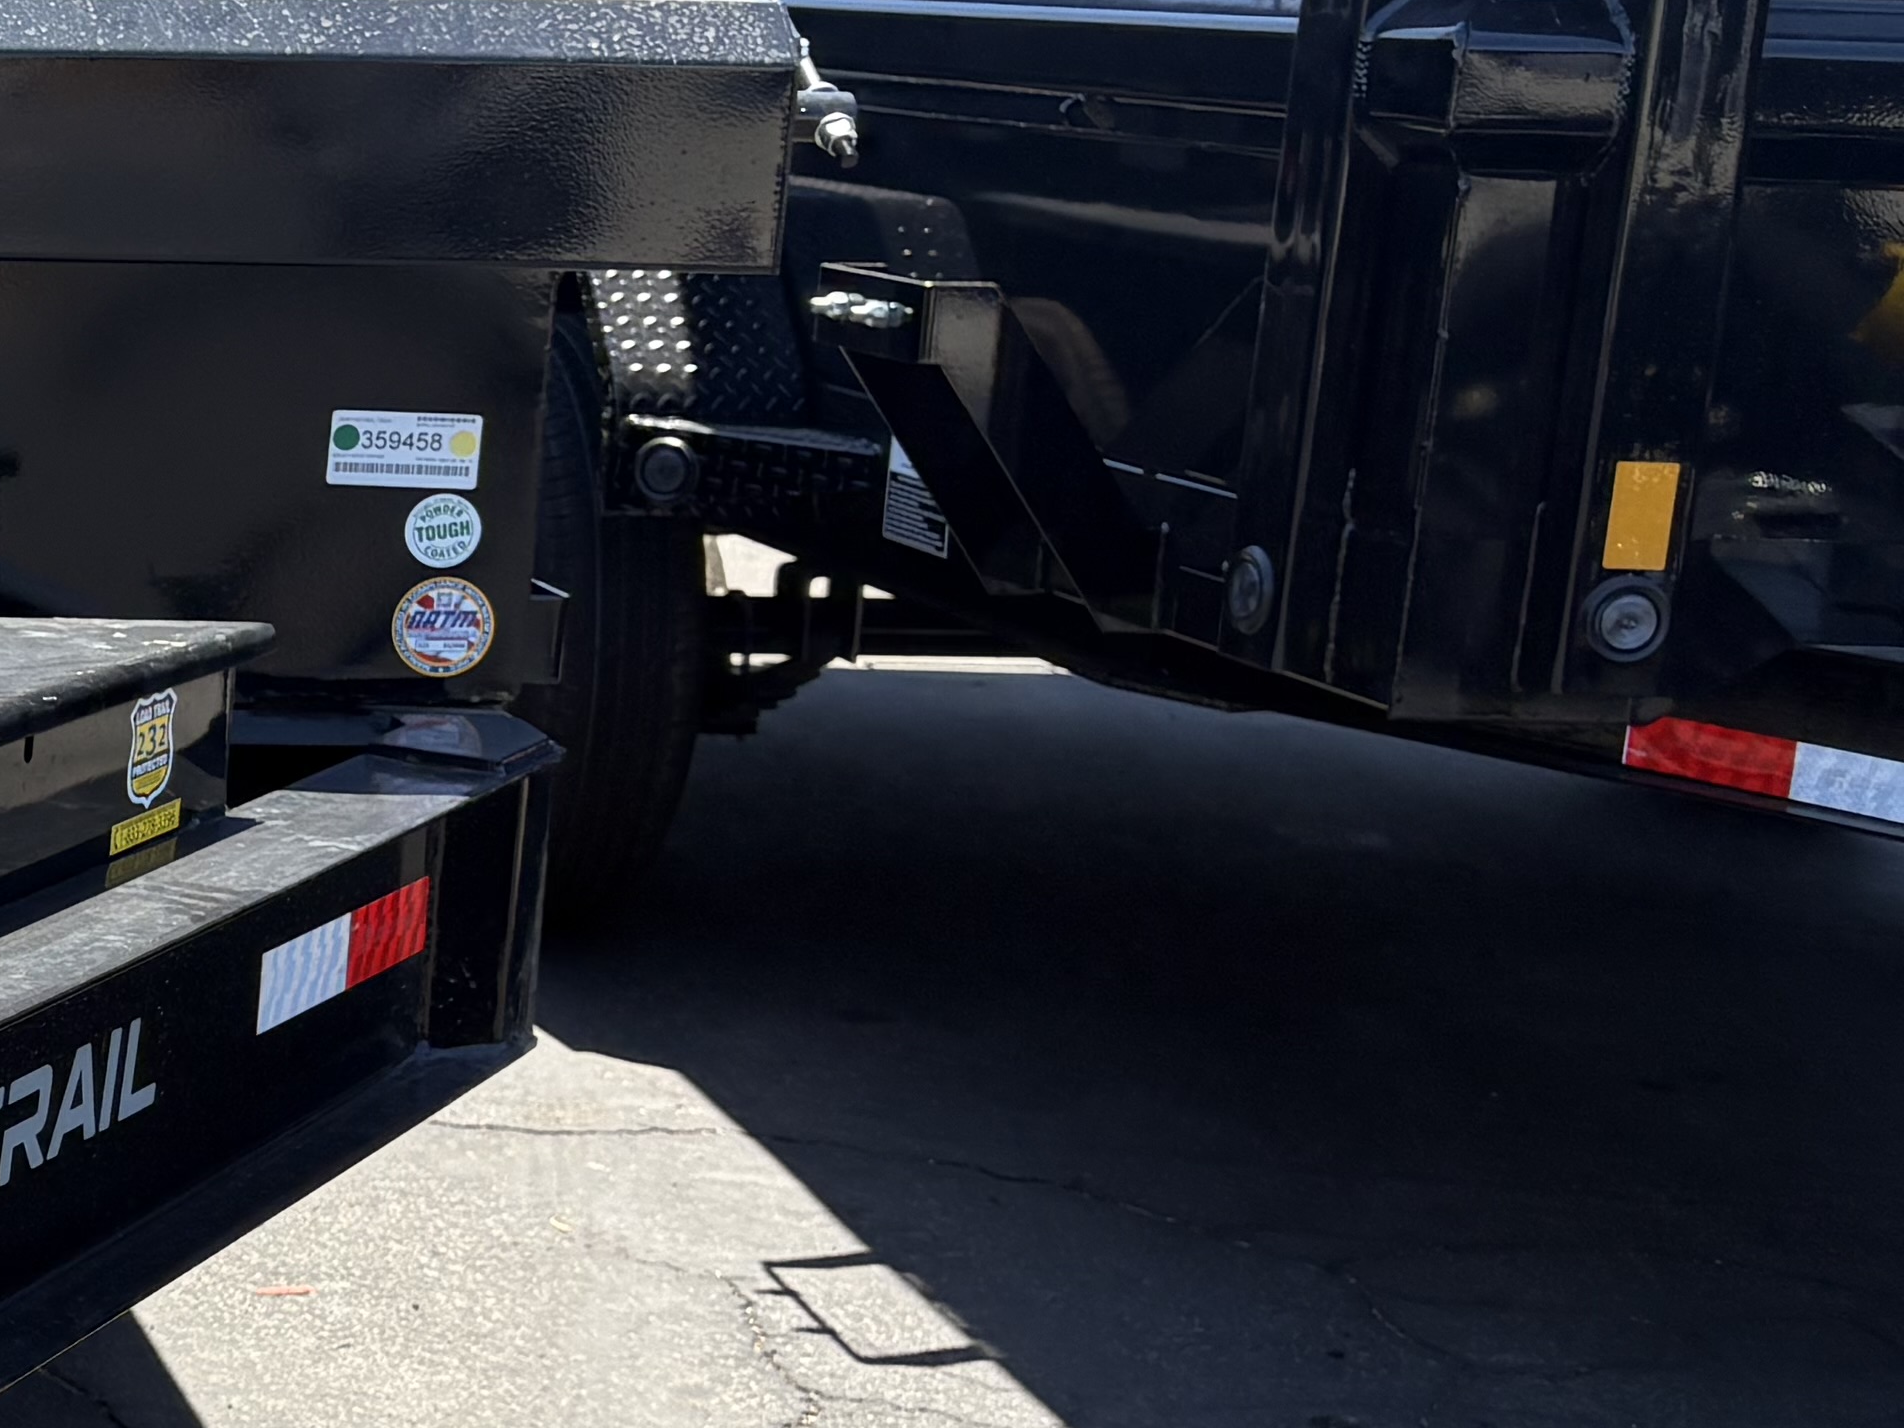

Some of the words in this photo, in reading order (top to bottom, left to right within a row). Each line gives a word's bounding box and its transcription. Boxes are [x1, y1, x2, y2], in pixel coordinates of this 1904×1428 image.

[360, 430, 443, 452] 359458
[420, 503, 464, 524] POWDER
[414, 520, 471, 543] TOUGH
[424, 540, 469, 559] COATED
[136, 724, 167, 757] 232
